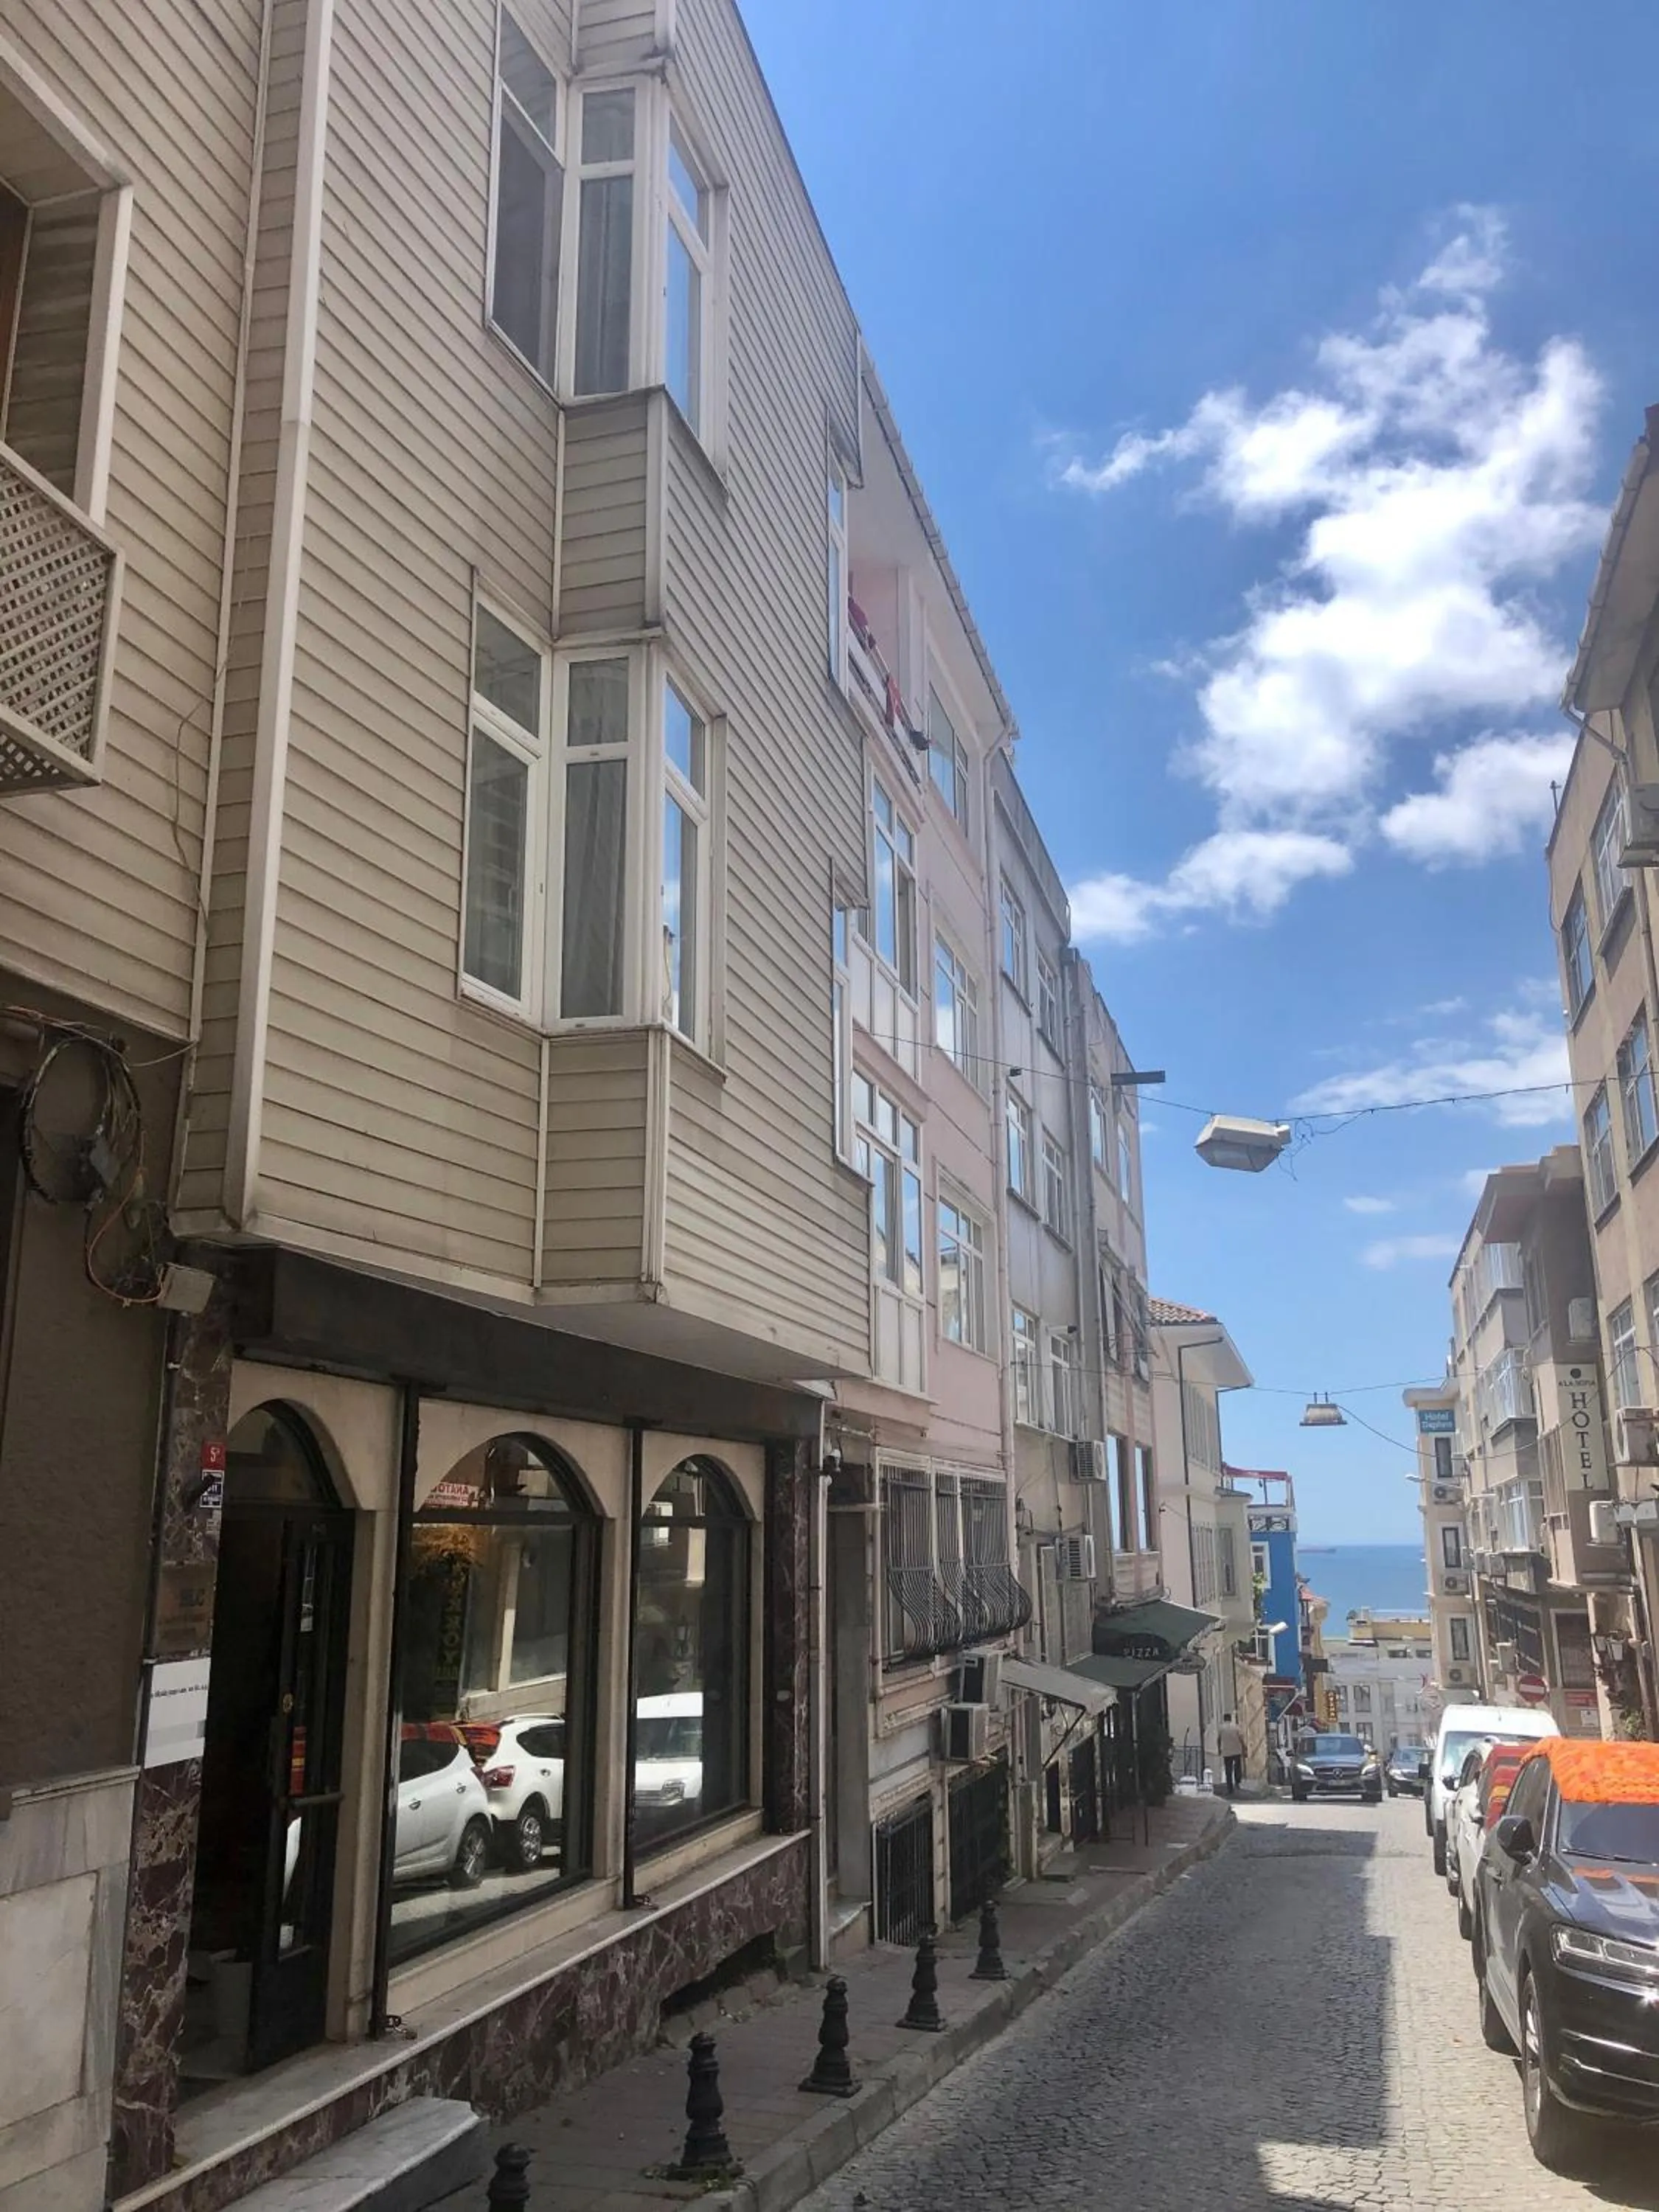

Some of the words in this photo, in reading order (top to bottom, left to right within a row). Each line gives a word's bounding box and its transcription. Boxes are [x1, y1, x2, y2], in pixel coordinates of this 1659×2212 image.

[1425, 1411, 1449, 1421] Hotel
[1571, 1392, 1593, 1489] HOTEL
[1123, 1646, 1159, 1659] PIZZA
